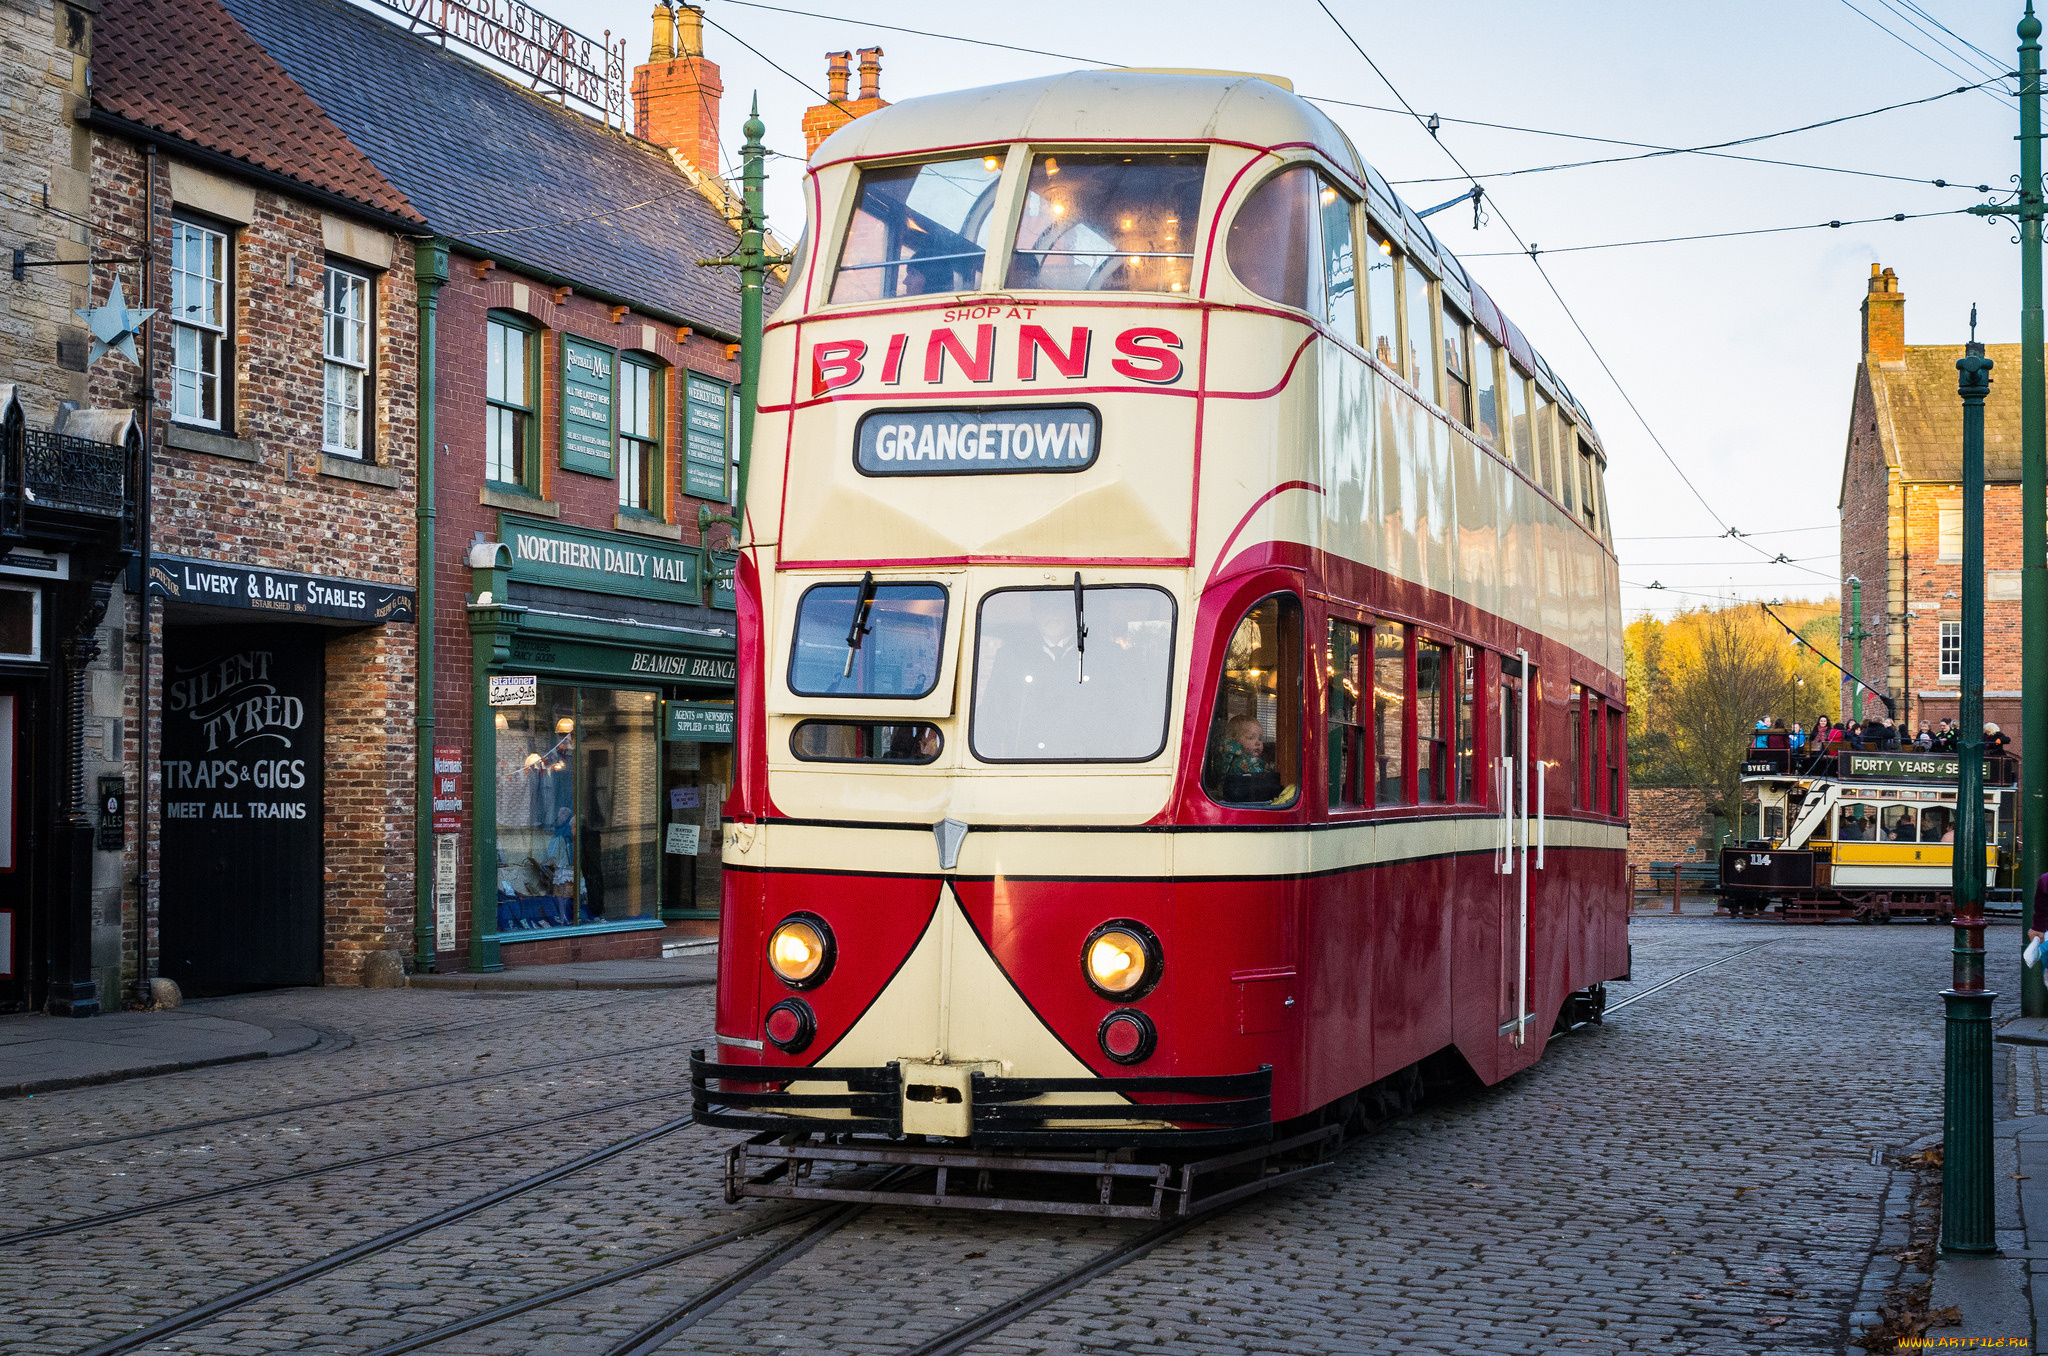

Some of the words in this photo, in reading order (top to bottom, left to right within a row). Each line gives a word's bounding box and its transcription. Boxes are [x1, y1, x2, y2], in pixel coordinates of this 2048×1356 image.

[461, 0, 596, 74] BLISHERS,
[944, 307, 1000, 322] SHOP
[1004, 308, 1036, 320] AT
[592, 356, 611, 378] MAIL
[812, 324, 1183, 399] BINNS
[574, 388, 582, 398] THE
[582, 390, 598, 402] LATEST
[598, 394, 610, 406] NEWS
[688, 386, 710, 402] WEEKLY
[711, 394, 726, 406] ECHO
[570, 406, 591, 418] FOOTBALL
[592, 411, 606, 422] WORLD
[692, 417, 702, 426] PRICE
[694, 408, 708, 419] TWELVE
[876, 422, 1090, 461] GRANGETOWN
[516, 534, 600, 570] NORTHERN
[604, 552, 648, 577] DAILY
[652, 556, 688, 583] MAIL
[184, 566, 238, 595] LIVERY
[248, 574, 260, 598] &
[266, 578, 298, 602] BAIT
[307, 581, 366, 608] STABLES
[252, 599, 290, 610] ESTABLISHED
[294, 604, 306, 612] 1860
[374, 602, 392, 618] JOSEPH
[392, 598, 397, 609] G
[397, 596, 412, 613] CARR
[536, 652, 556, 663] GOODS
[630, 653, 687, 675] BEAMISH
[692, 659, 736, 679] BRANCH
[170, 651, 272, 711] SILENT
[492, 677, 534, 685] Stationer
[204, 696, 304, 752] TYRED
[674, 710, 695, 720] AGENTS
[705, 711, 734, 722] NEWSBOYS
[678, 721, 702, 732] SUPPLIED
[715, 723, 730, 733] BACK
[162, 760, 239, 789] TRAPS
[240, 766, 251, 781] &
[254, 760, 306, 789] GIGS
[1747, 764, 1771, 772] BYKER
[1854, 760, 1892, 771] FORTY
[1898, 762, 1935, 774] YEARS
[442, 778, 455, 794] Ideal
[168, 802, 206, 818] MEET
[212, 802, 243, 818] ALL
[248, 802, 306, 819] TRAINS
[102, 816, 122, 827] ALES
[1750, 854, 1771, 866] 114
